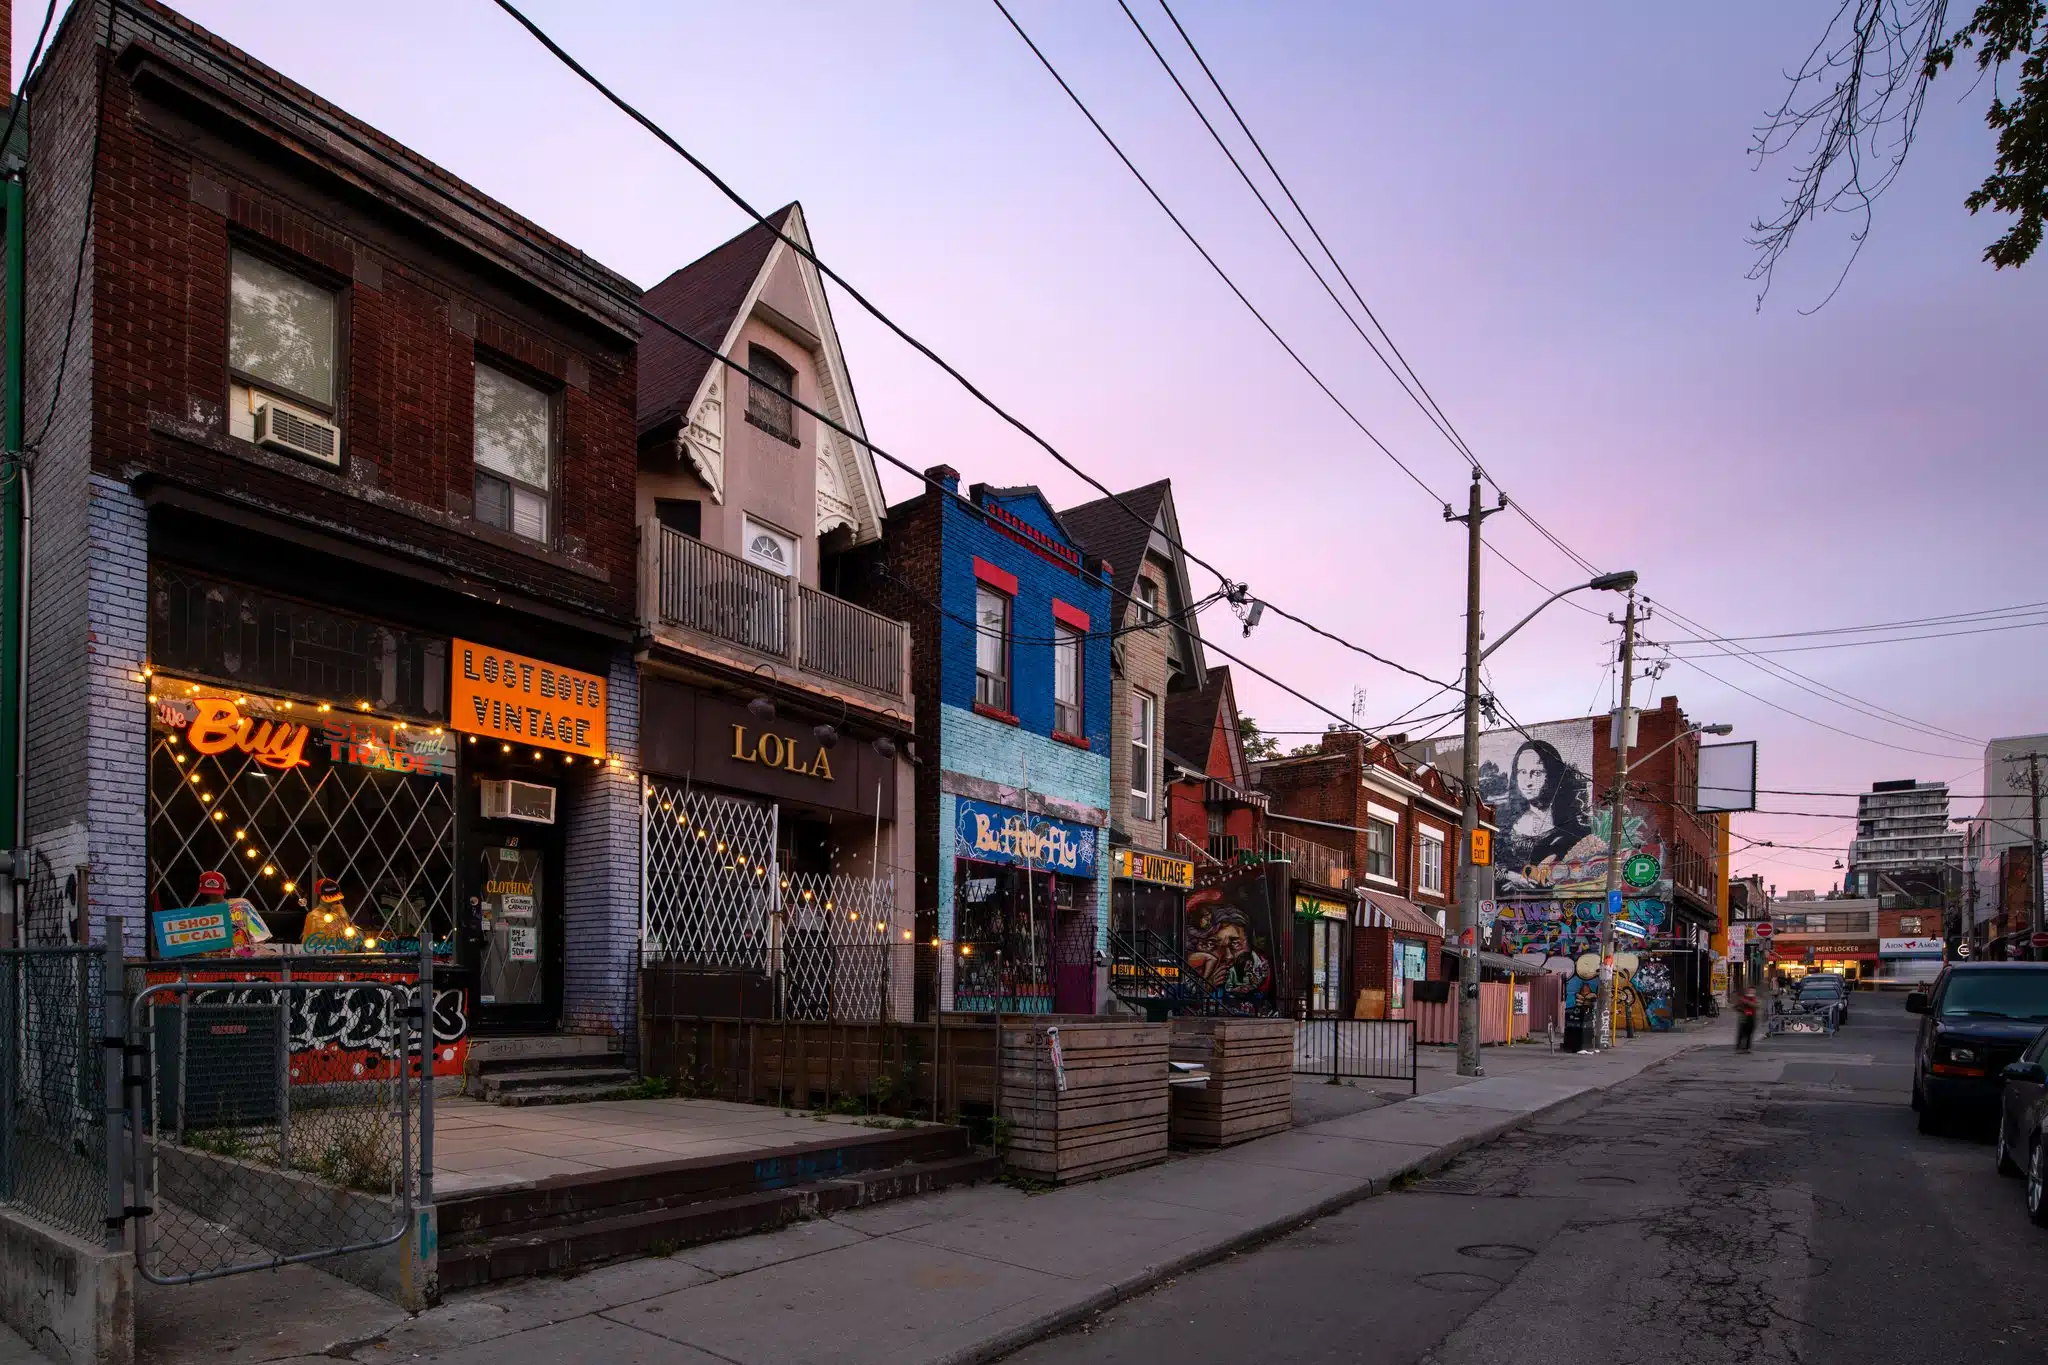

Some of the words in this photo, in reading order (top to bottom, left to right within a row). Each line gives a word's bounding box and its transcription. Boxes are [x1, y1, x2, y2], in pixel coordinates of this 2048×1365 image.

[464, 650, 534, 693] LOST
[541, 668, 600, 708] BOYS
[158, 704, 187, 728] We
[186, 697, 312, 769] Buy
[472, 696, 591, 748] VINTAGE
[413, 735, 448, 756] and
[731, 723, 835, 781] LOLA
[974, 812, 1079, 870] Butterfly
[1475, 835, 1484, 846] NO
[1474, 849, 1486, 860] EXIT
[1146, 856, 1187, 884] VINTAGE
[1634, 862, 1650, 877] P
[486, 880, 534, 896] CLOTHING
[168, 922, 172, 931] I
[178, 916, 221, 930] SHOP
